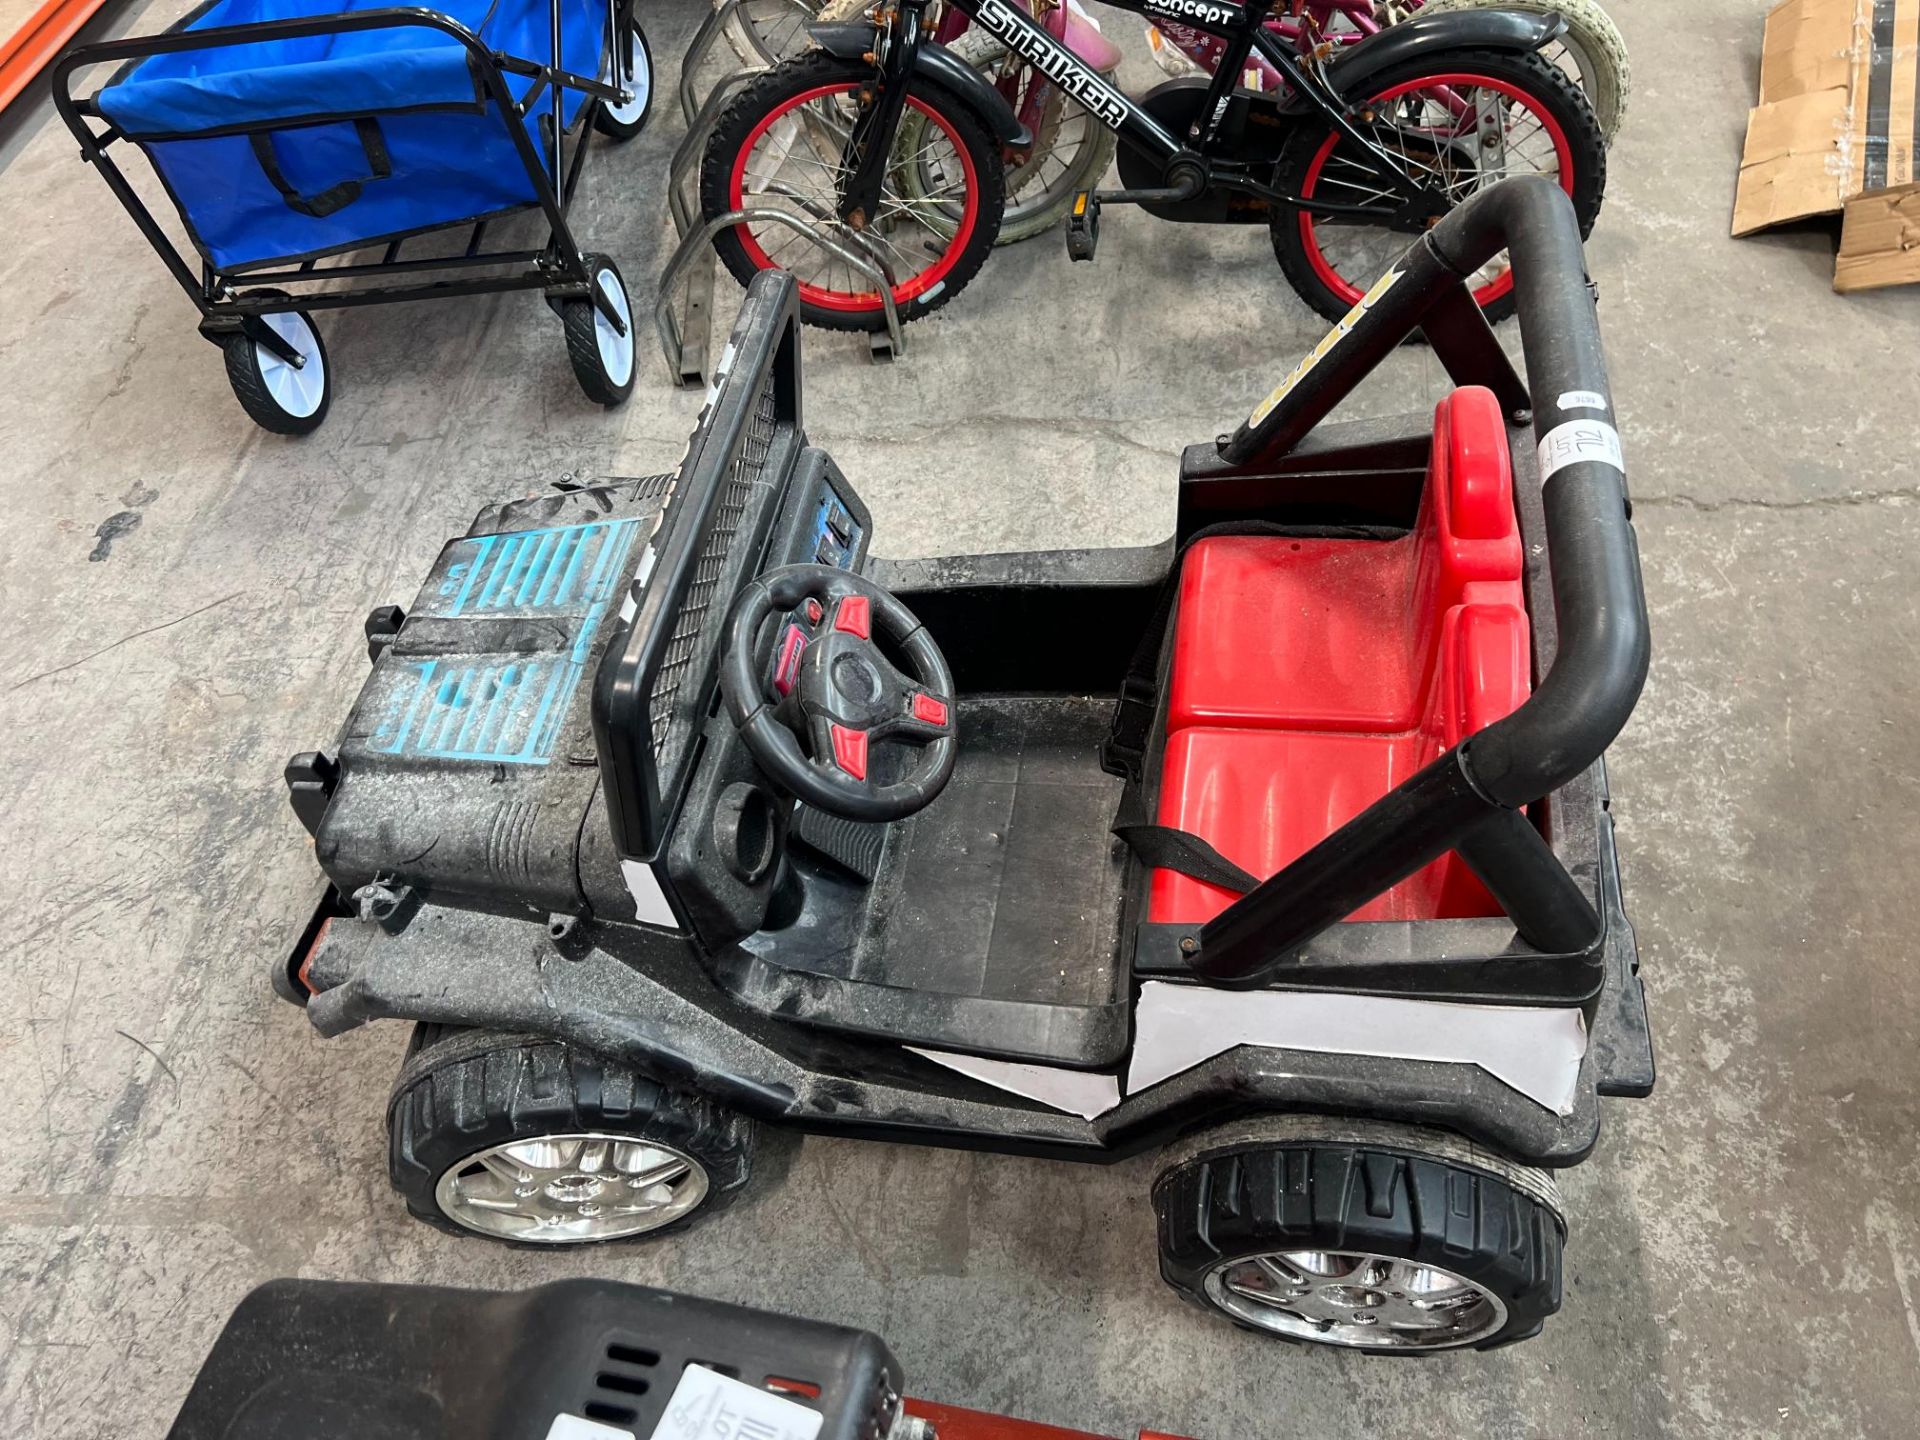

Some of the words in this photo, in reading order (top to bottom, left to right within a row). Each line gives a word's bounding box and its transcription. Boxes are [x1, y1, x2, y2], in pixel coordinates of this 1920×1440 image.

[976, 0, 1129, 129] STRIKER
[1556, 436, 1572, 457] LOT
[712, 1401, 737, 1440] OT
